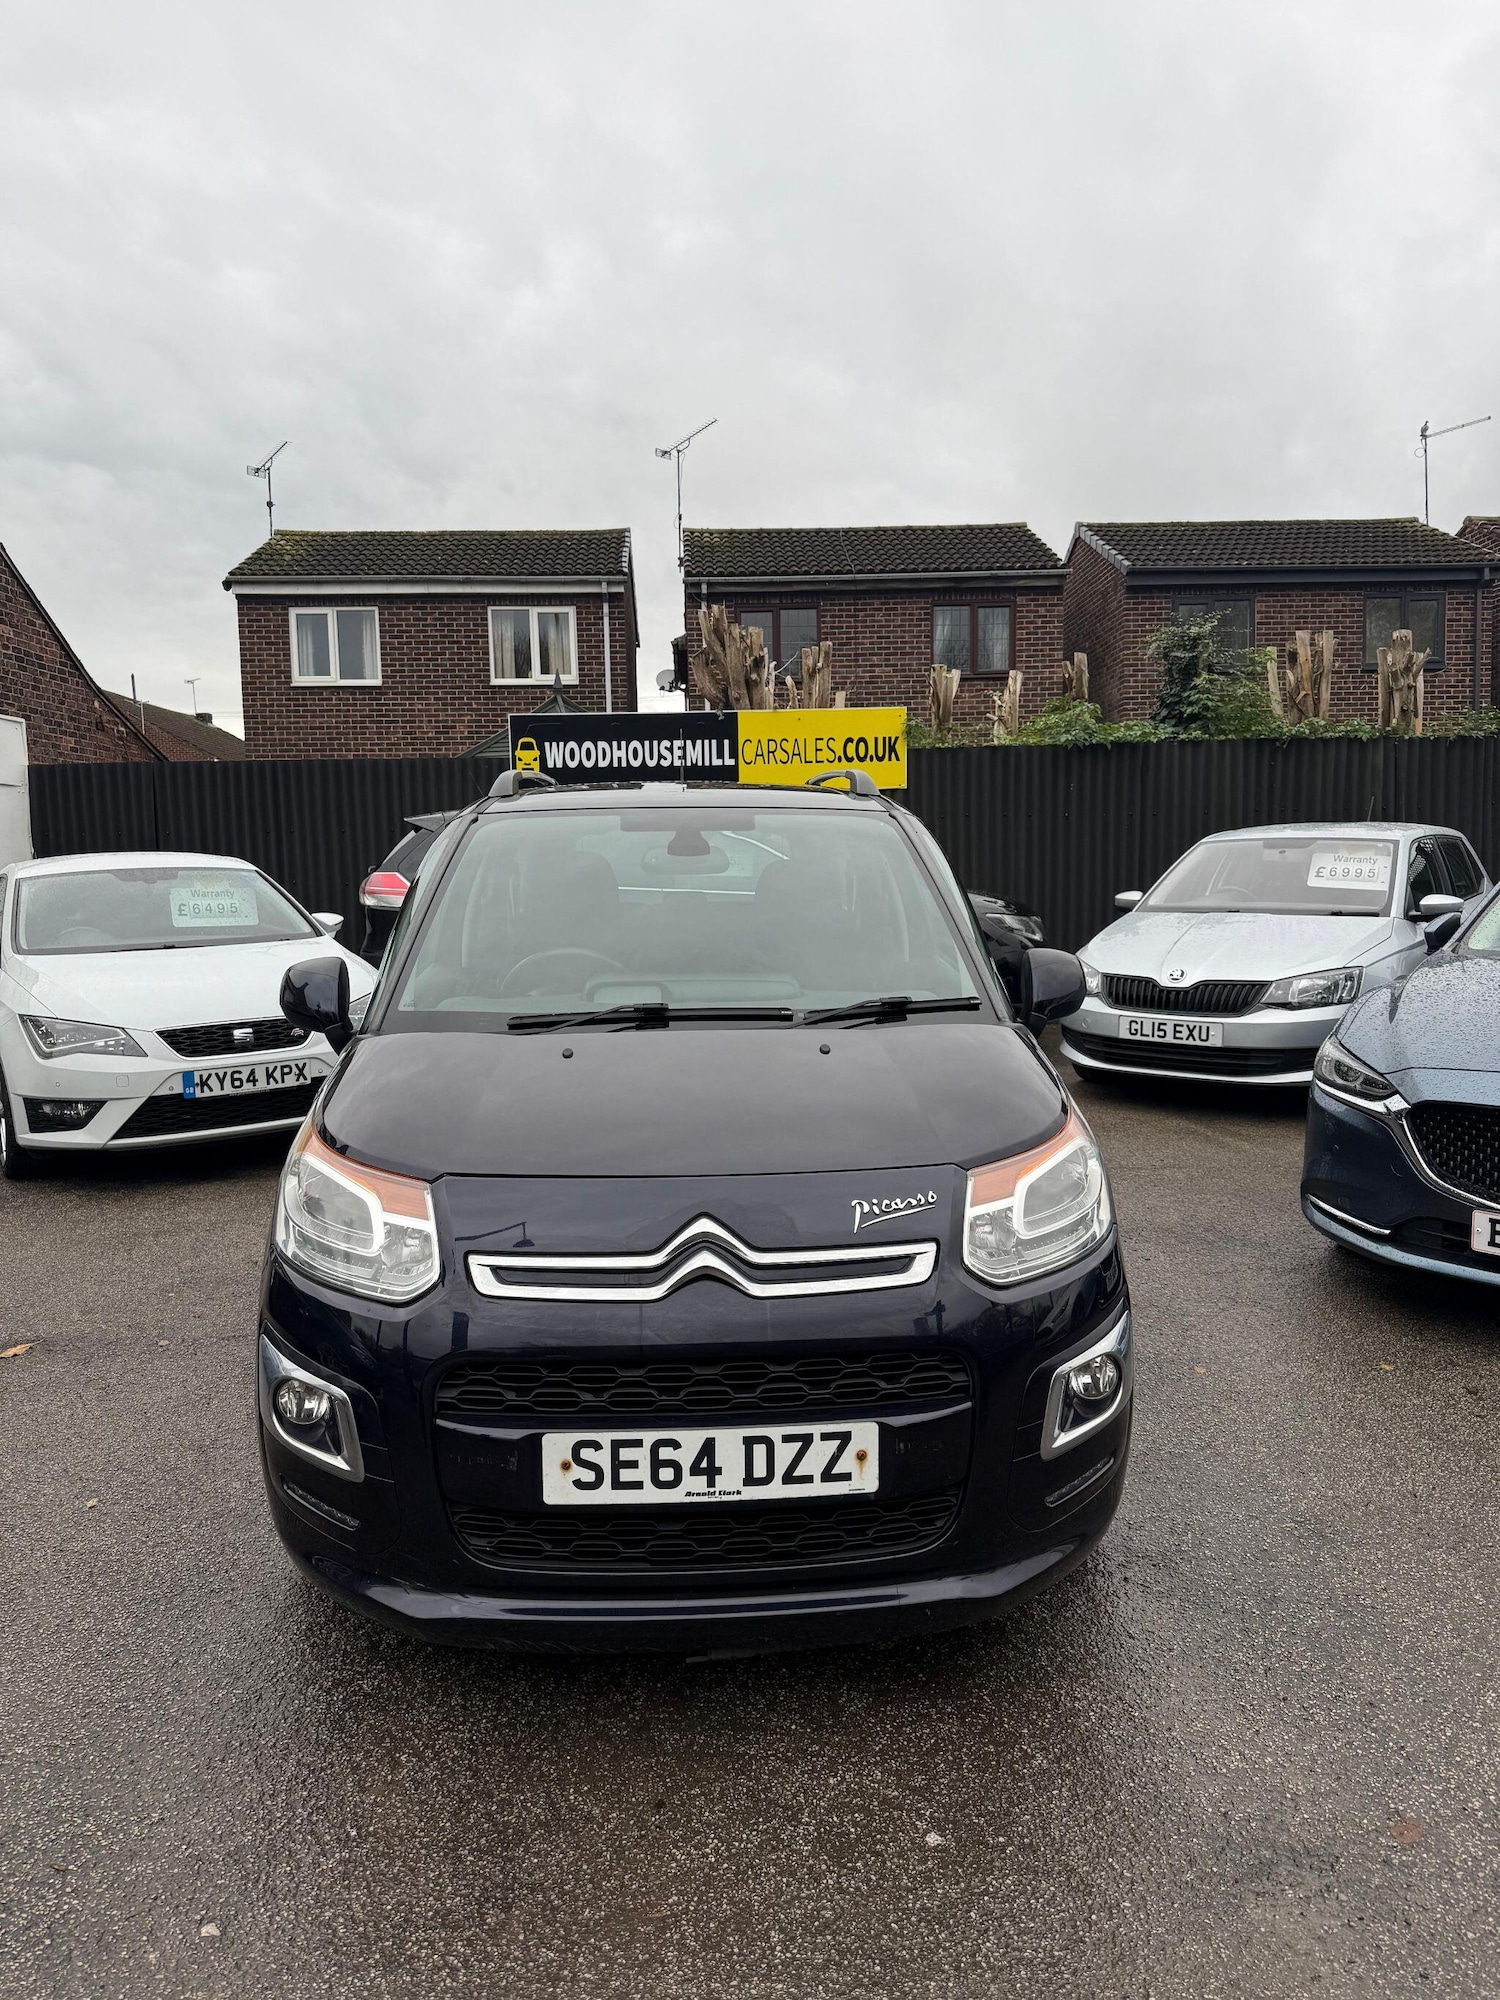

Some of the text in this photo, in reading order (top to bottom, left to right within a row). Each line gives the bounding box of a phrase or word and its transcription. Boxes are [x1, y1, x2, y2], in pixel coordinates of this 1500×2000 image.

[544, 735, 901, 769] WOODHOUSEMILL CARSALES.CO.UK
[1333, 855, 1378, 865] Warranty
[1314, 866, 1376, 879] £6995
[190, 889, 235, 899] Warranty
[177, 903, 238, 917] £6495
[1128, 1020, 1210, 1042] GL15 EXU
[199, 1067, 259, 1094] KY64
[265, 1062, 308, 1086] KPX
[571, 1430, 852, 1491] SE64 DZZ
